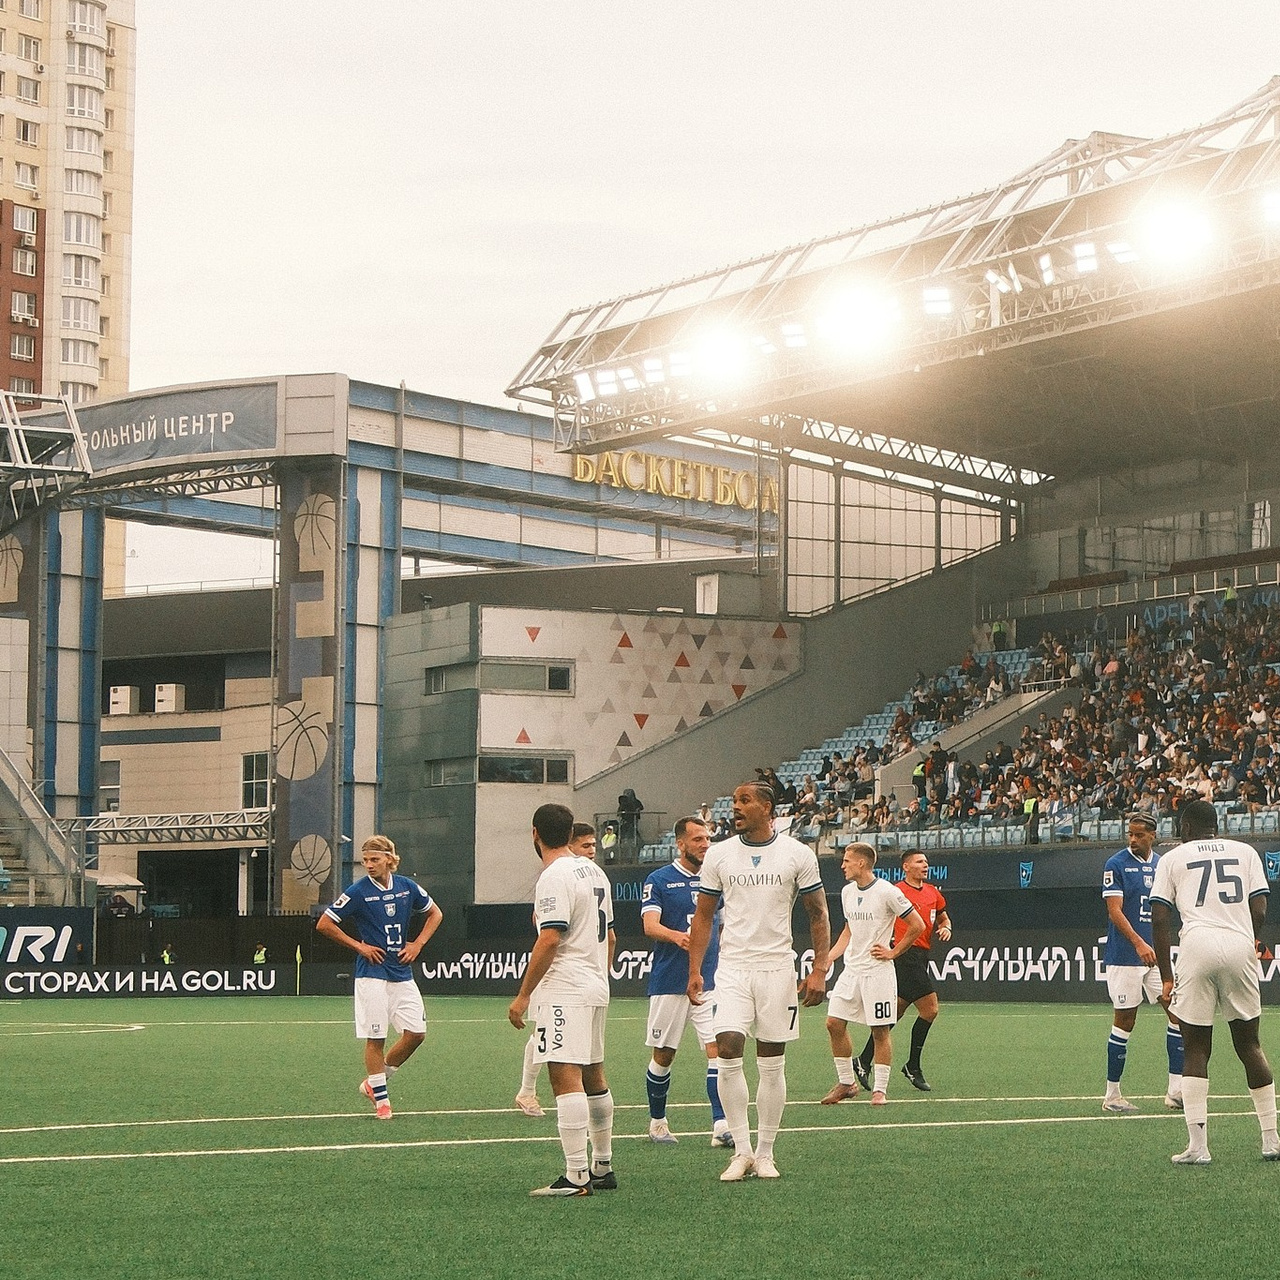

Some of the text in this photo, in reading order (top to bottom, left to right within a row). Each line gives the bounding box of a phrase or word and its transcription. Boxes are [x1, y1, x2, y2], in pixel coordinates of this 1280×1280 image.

[80, 411, 235, 451] БОЛЬНЫЙ ЦЕНТР
[572, 450, 780, 514] БАСКЕТБОЛ
[1186, 858, 1244, 908] 75
[594, 887, 607, 944] 3
[0, 925, 73, 963] RI
[5, 970, 276, 993] СТОРАХ И НА GOL.RU
[552, 1005, 566, 1051] Vorgol
[788, 1006, 798, 1031] 7
[874, 1001, 891, 1019] 80
[537, 1027, 547, 1054] 3
